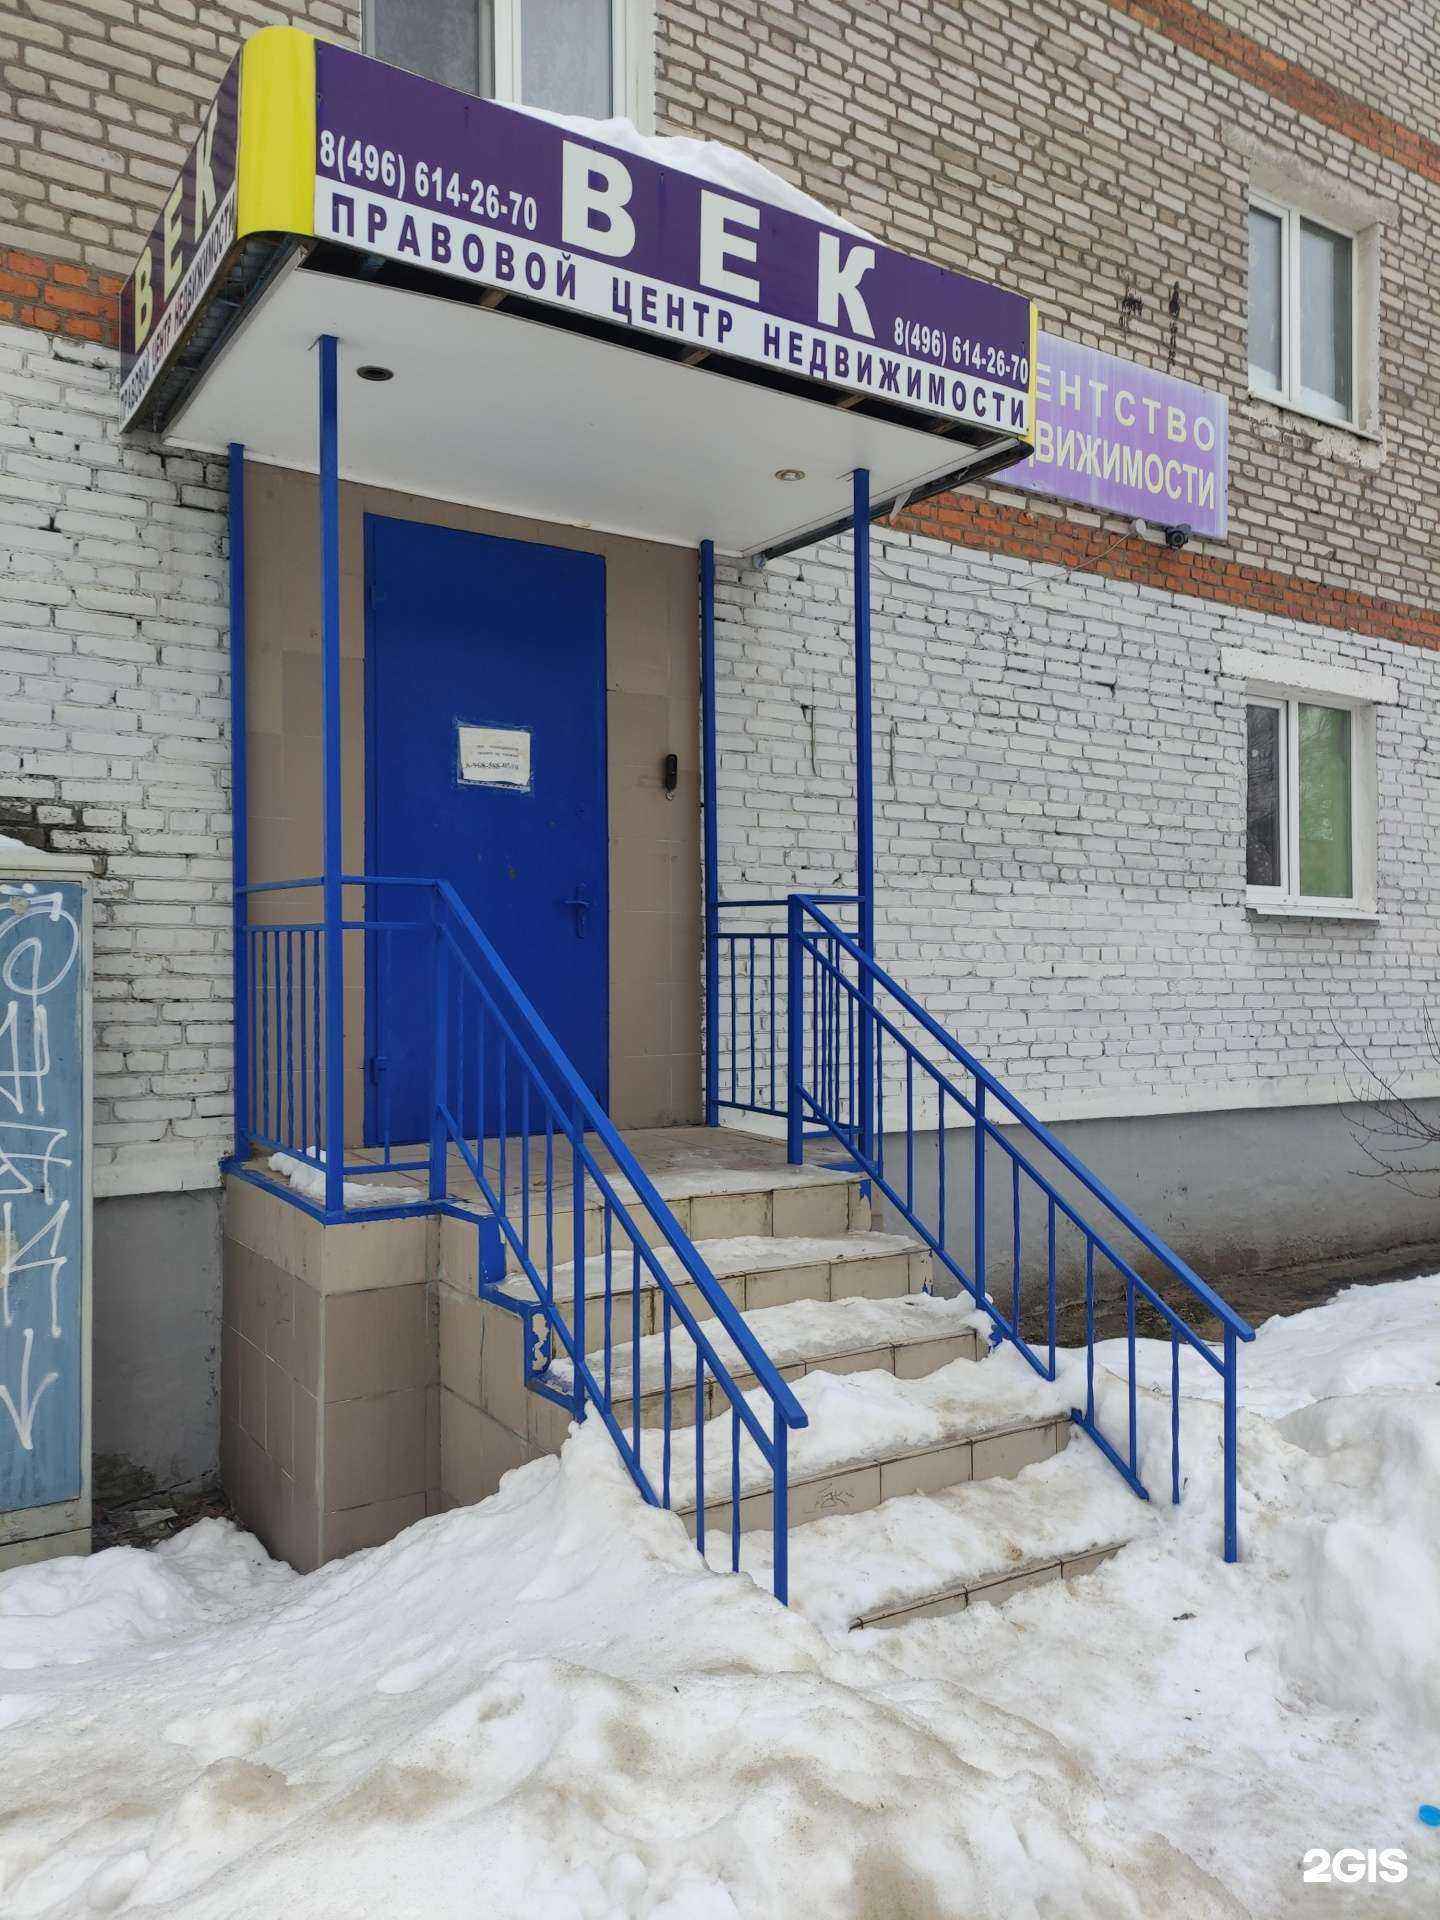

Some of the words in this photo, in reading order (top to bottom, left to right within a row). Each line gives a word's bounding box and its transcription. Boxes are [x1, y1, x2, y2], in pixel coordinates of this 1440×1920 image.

[134, 98, 218, 352] ВЕК
[320, 130, 406, 199] 8(496)
[415, 161, 537, 231] 614-26-70
[562, 139, 876, 339] ВЕК
[332, 192, 576, 300] ПРАВОВОЙ
[612, 277, 733, 343] ЦЕНТР
[763, 323, 1024, 428] НЕДВИЖИМОСТИ
[894, 317, 947, 367] 8(496)
[952, 336, 1029, 385] 614-26-70
[1028, 419, 1215, 510] ВИЖИМОСТИ
